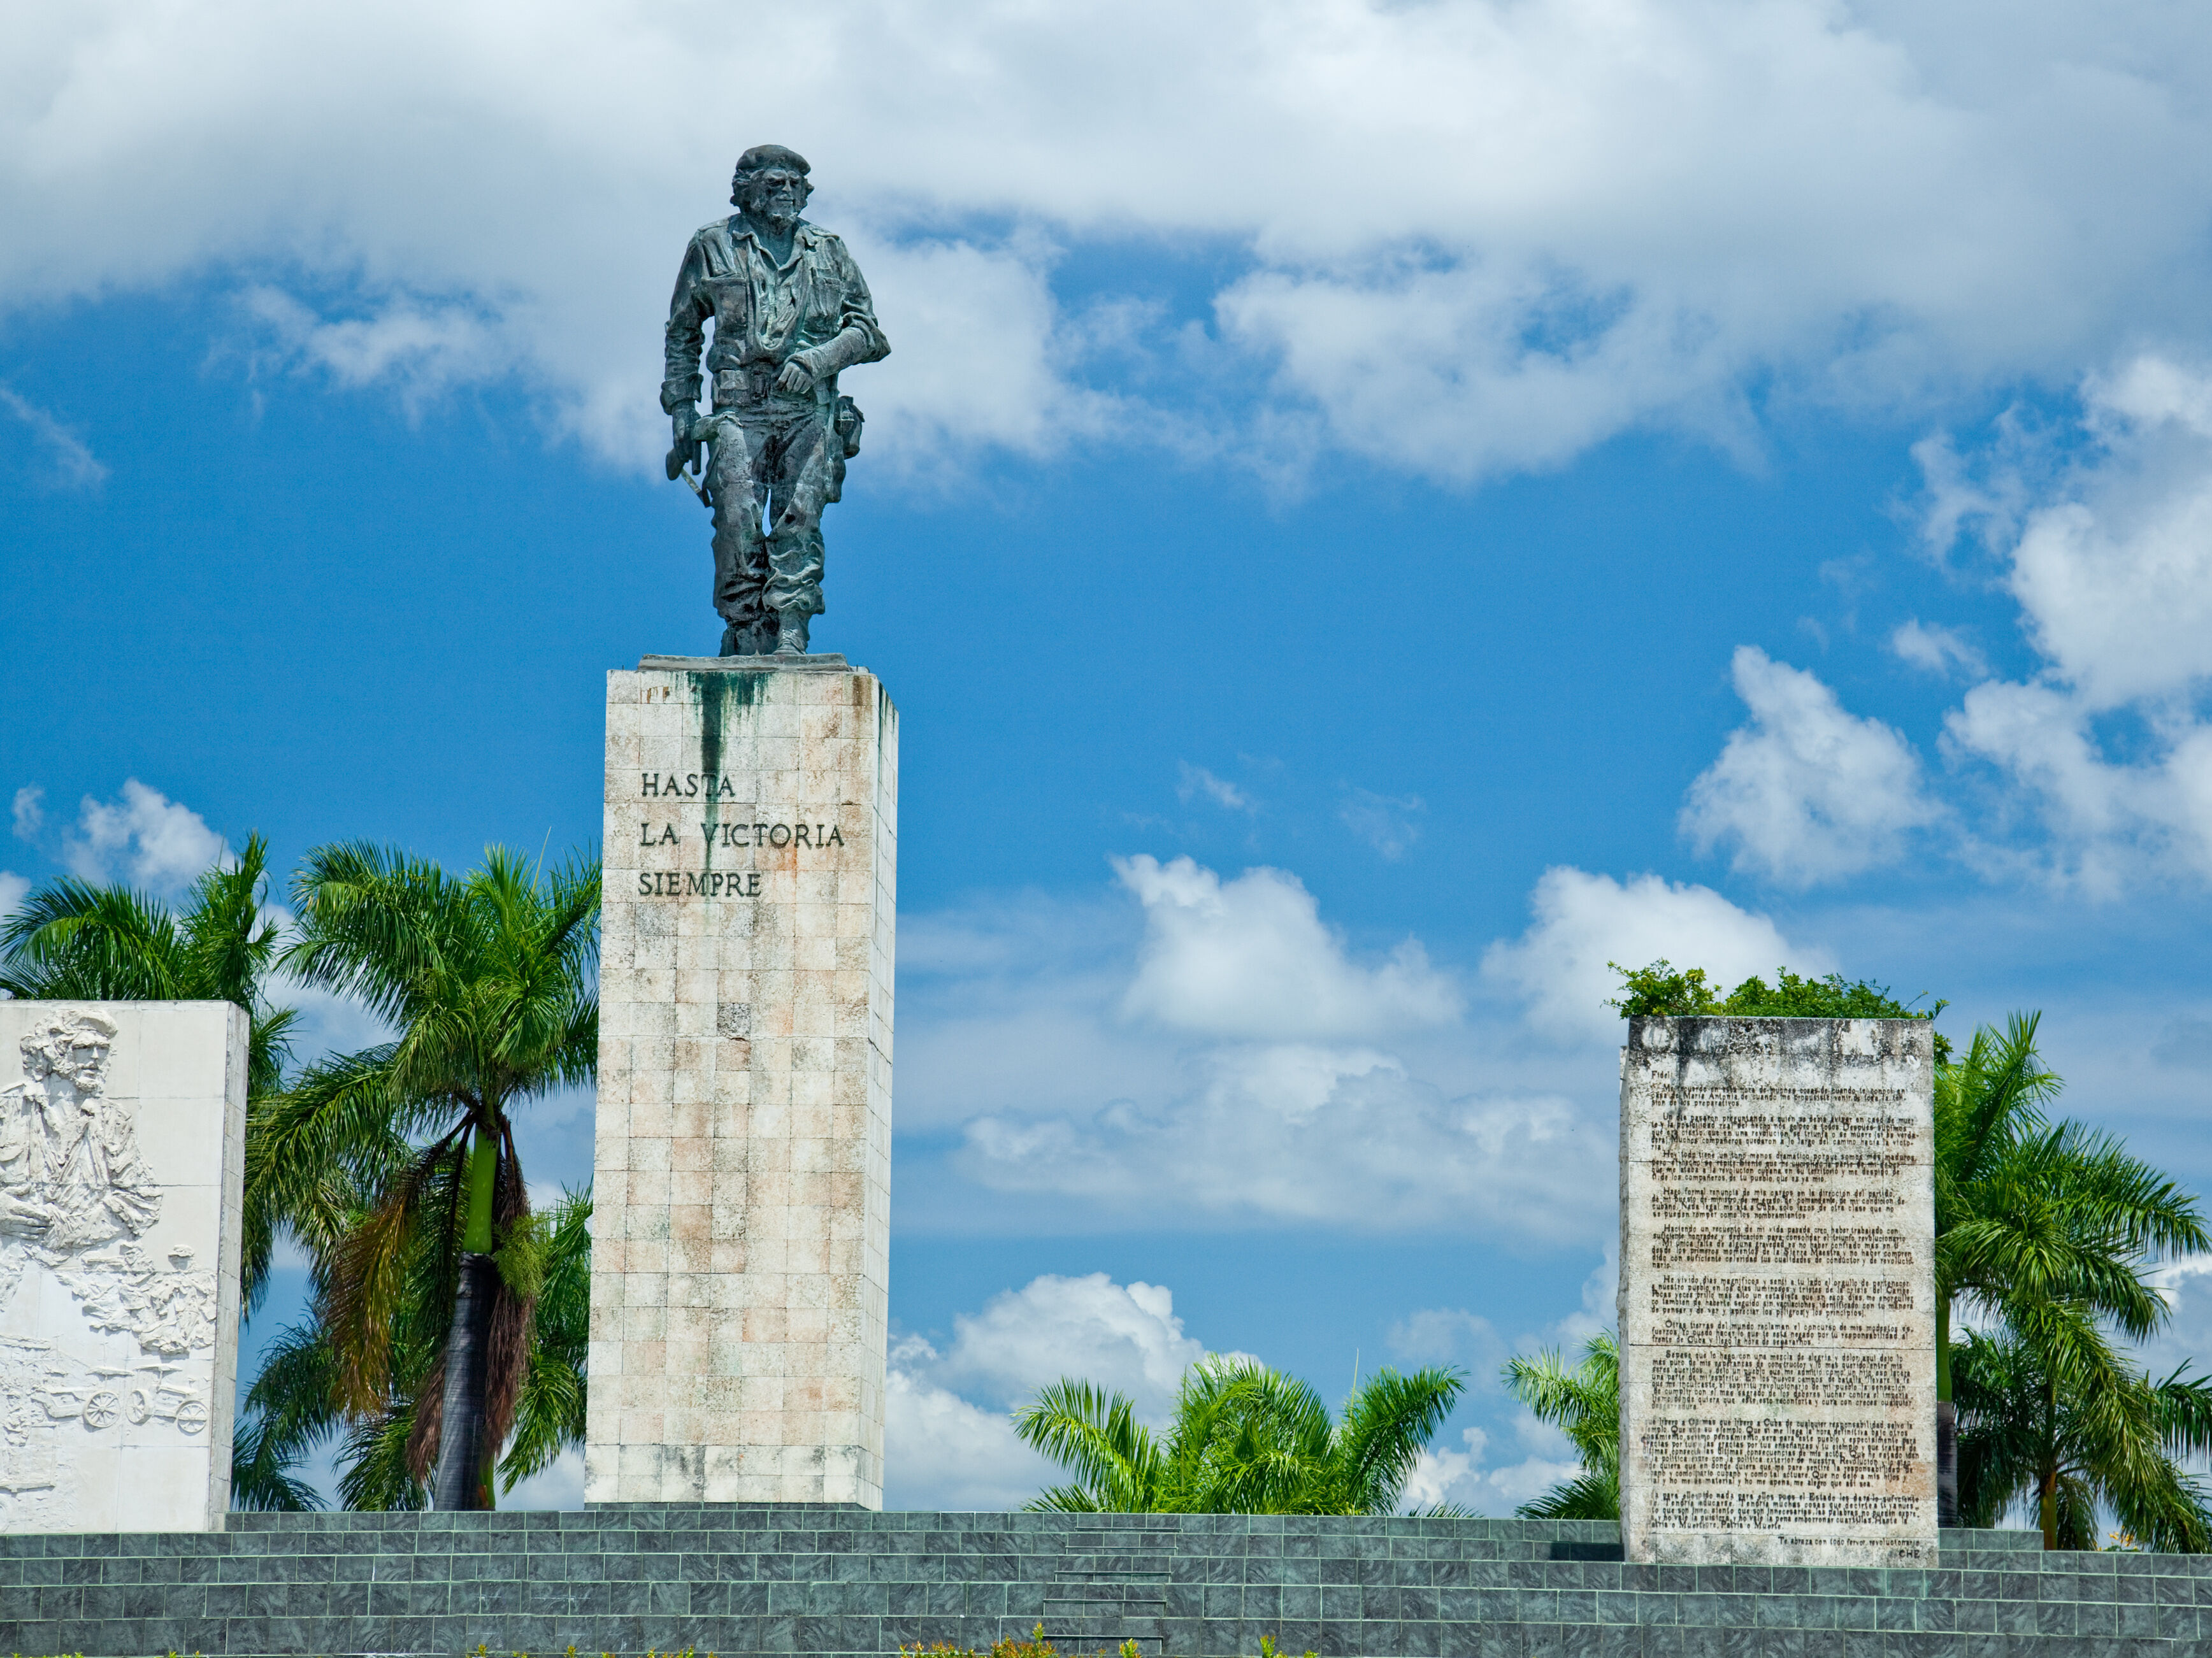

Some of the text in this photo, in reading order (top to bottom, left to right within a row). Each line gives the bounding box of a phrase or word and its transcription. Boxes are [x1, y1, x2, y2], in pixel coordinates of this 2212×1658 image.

[642, 773, 735, 797] HASTA
[640, 824, 845, 847] LA VICTORIA
[638, 873, 762, 897] SIEMPRE
[1830, 1538, 1844, 1546] todo
[1899, 1550, 1920, 1558] CHE
